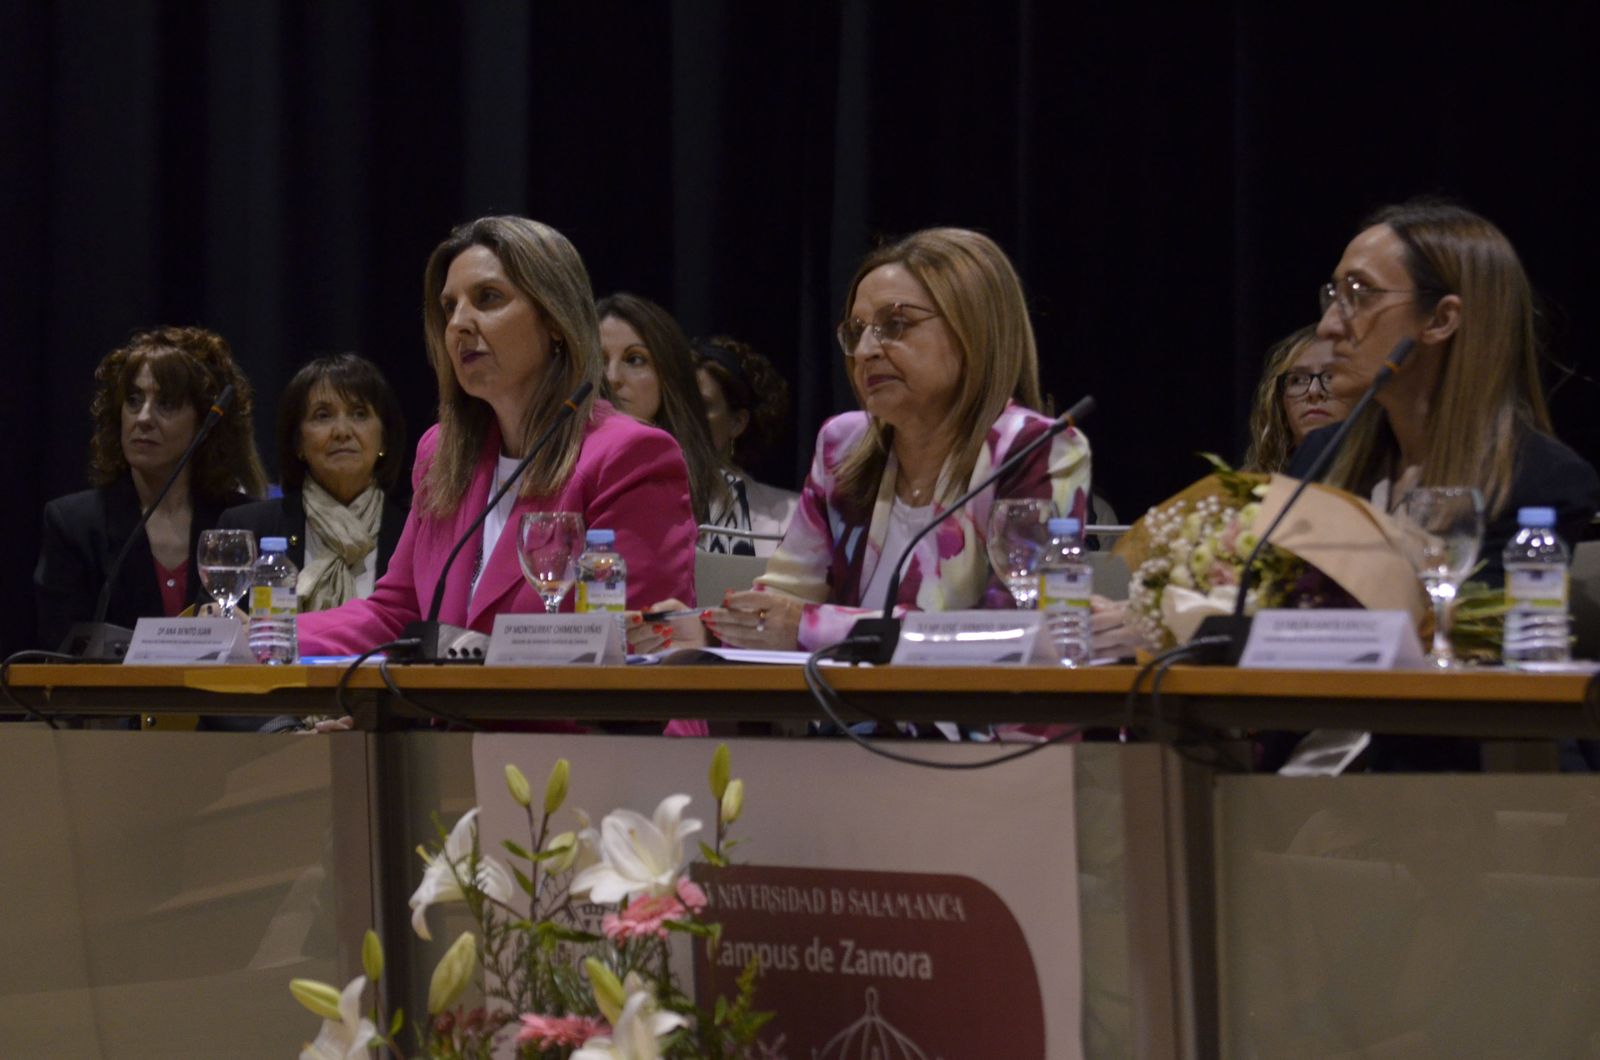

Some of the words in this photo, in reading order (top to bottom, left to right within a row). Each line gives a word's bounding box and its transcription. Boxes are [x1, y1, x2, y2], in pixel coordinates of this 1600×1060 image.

[514, 624, 552, 634] MONTSERRAT
[553, 624, 583, 634] CHIMENO
[584, 622, 603, 634] VIÑAS
[849, 887, 967, 923] SALAMANCA
[804, 936, 835, 973] de
[839, 939, 933, 980] Zamora
